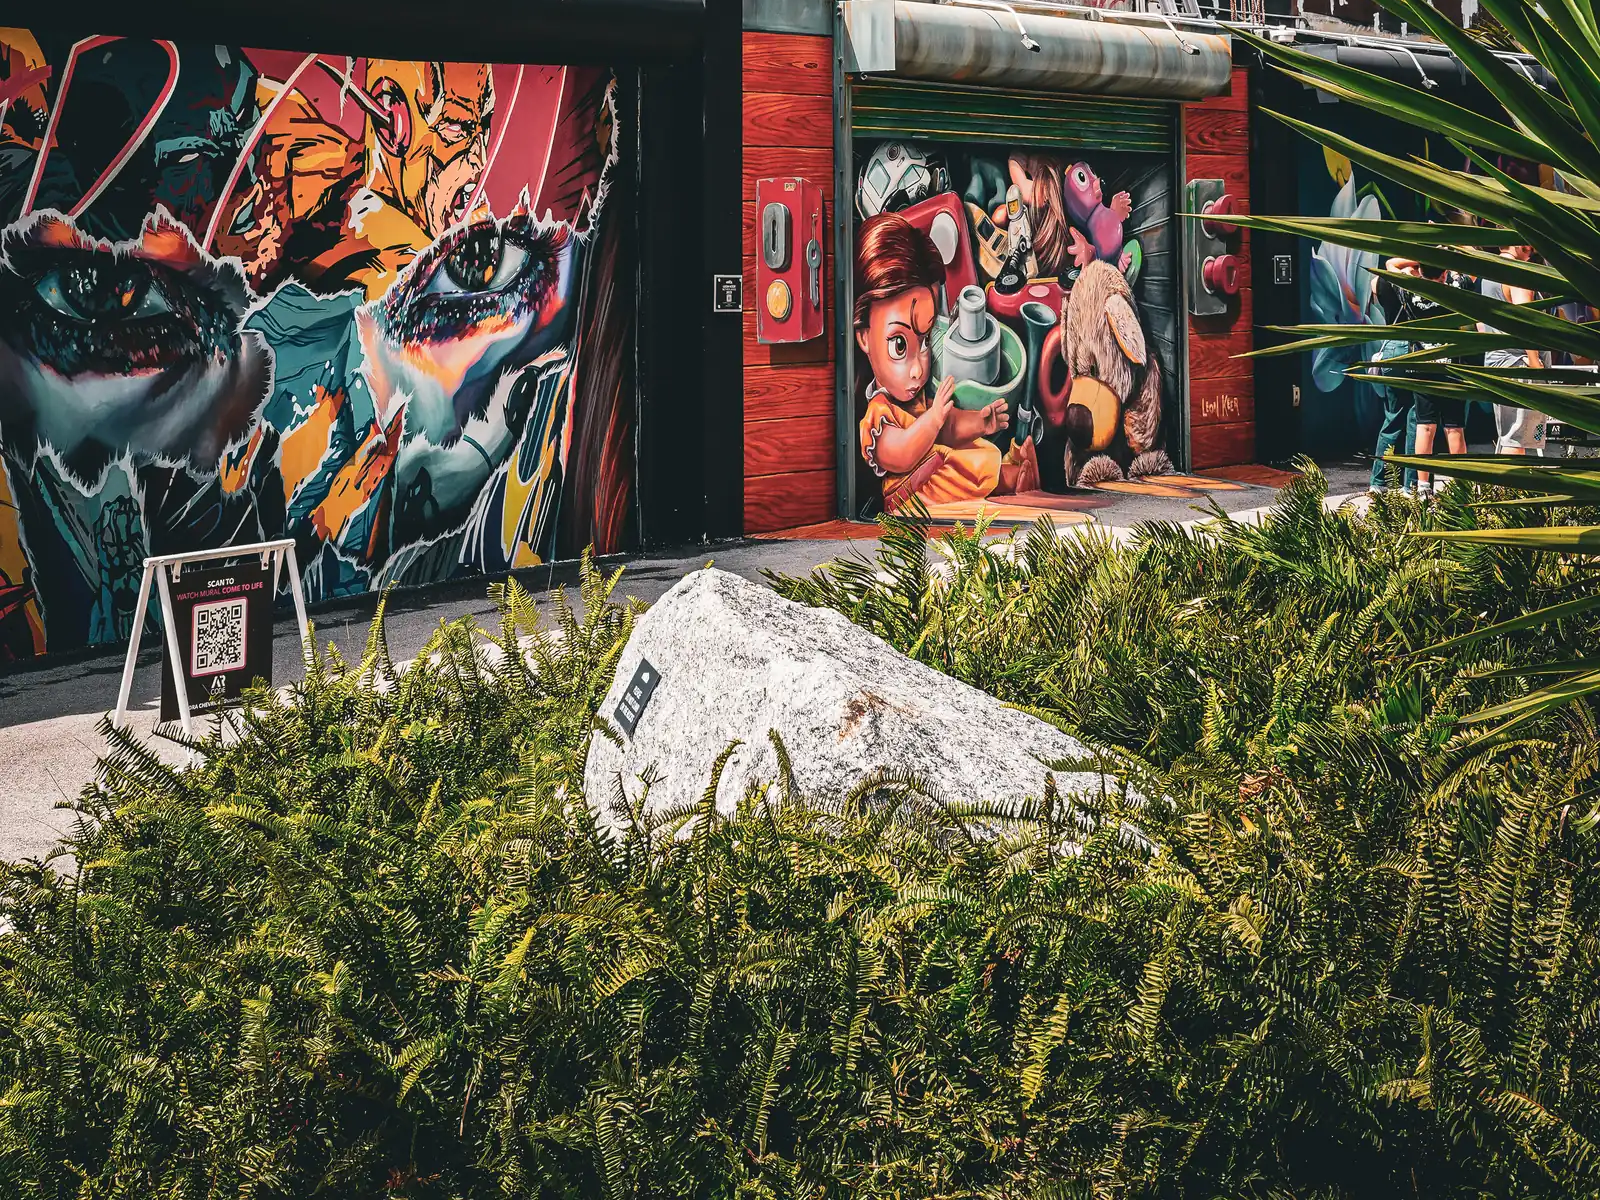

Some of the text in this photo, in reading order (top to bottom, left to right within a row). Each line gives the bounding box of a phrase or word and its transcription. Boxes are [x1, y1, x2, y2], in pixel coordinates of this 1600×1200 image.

[207, 577, 235, 588] SCAN TO
[176, 581, 264, 601] WATCH MURAL COME TO LIFE
[211, 674, 226, 689] AR
[210, 687, 226, 696] CODE
